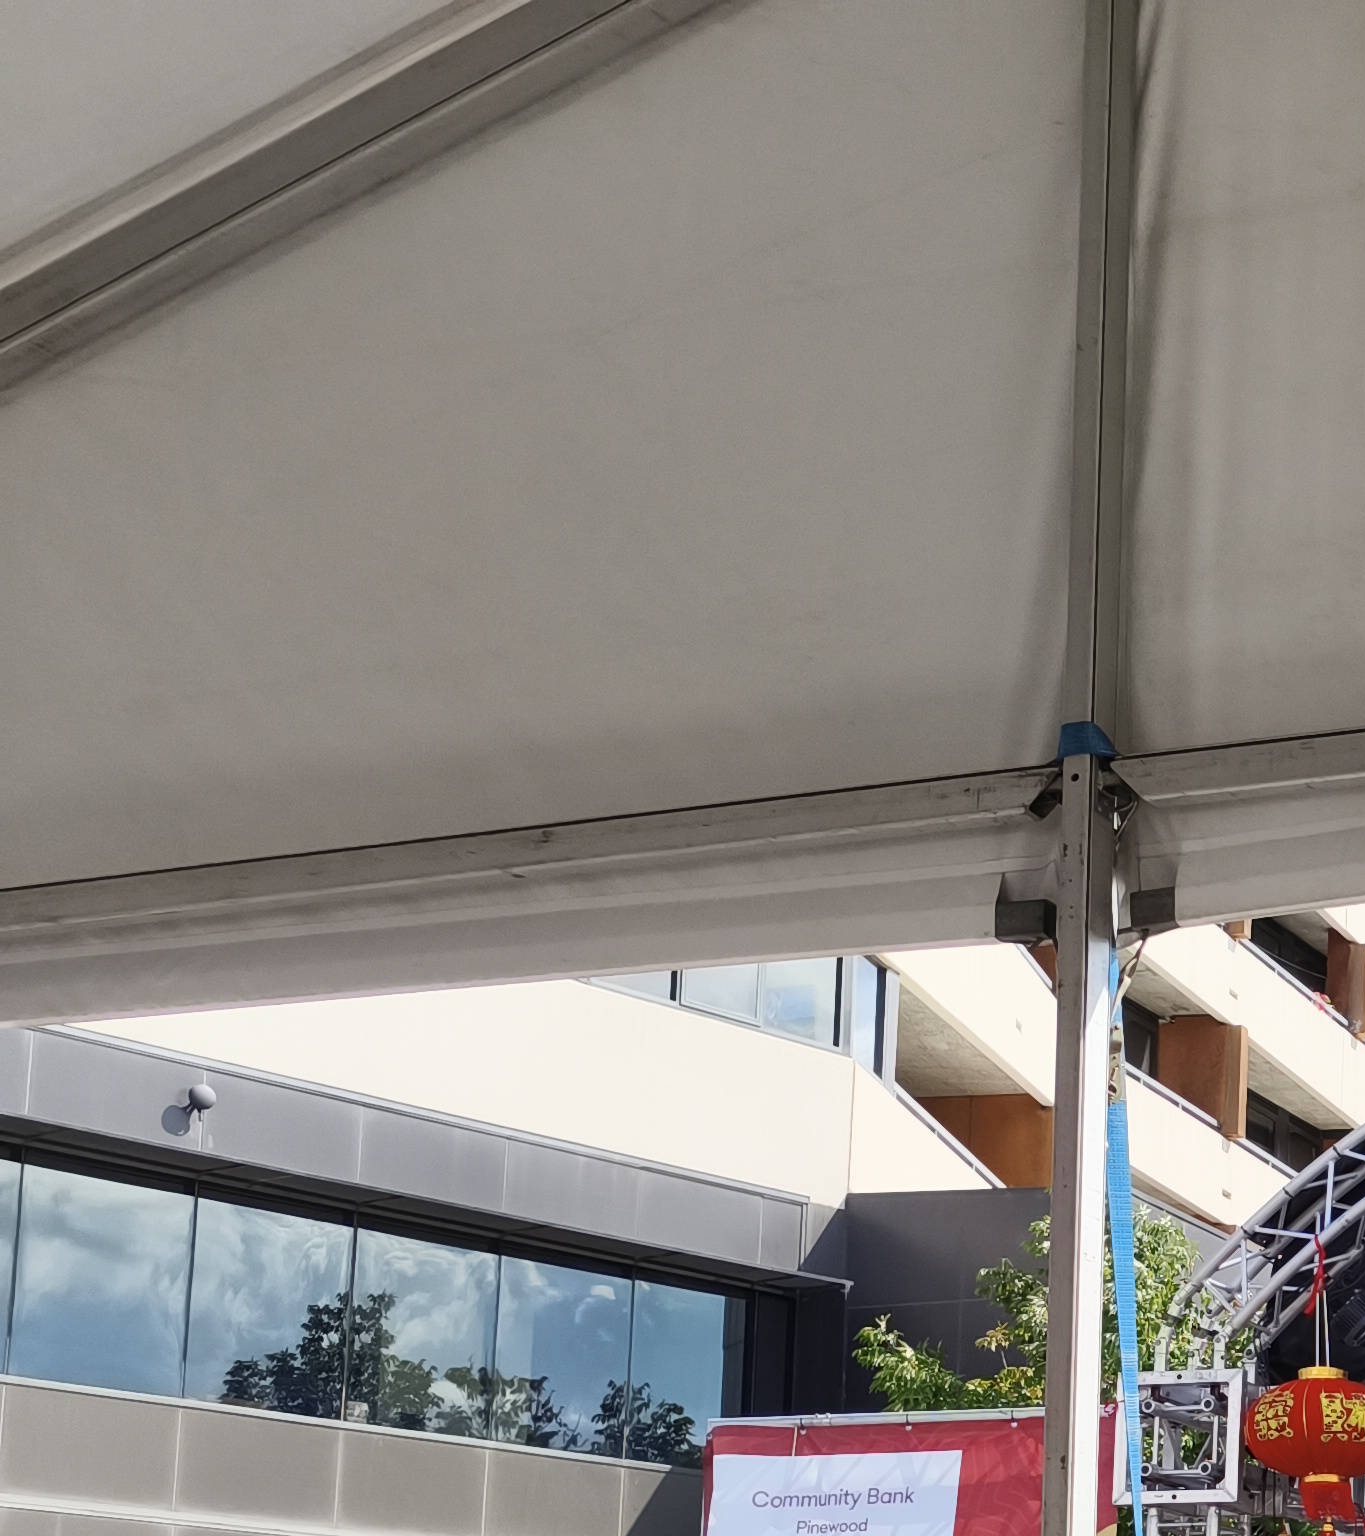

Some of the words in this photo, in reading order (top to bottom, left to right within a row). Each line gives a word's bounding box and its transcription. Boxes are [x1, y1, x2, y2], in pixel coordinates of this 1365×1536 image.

[752, 1488, 862, 1510] Community
[867, 1486, 915, 1505] Bank
[796, 1518, 869, 1534] Pinewood
